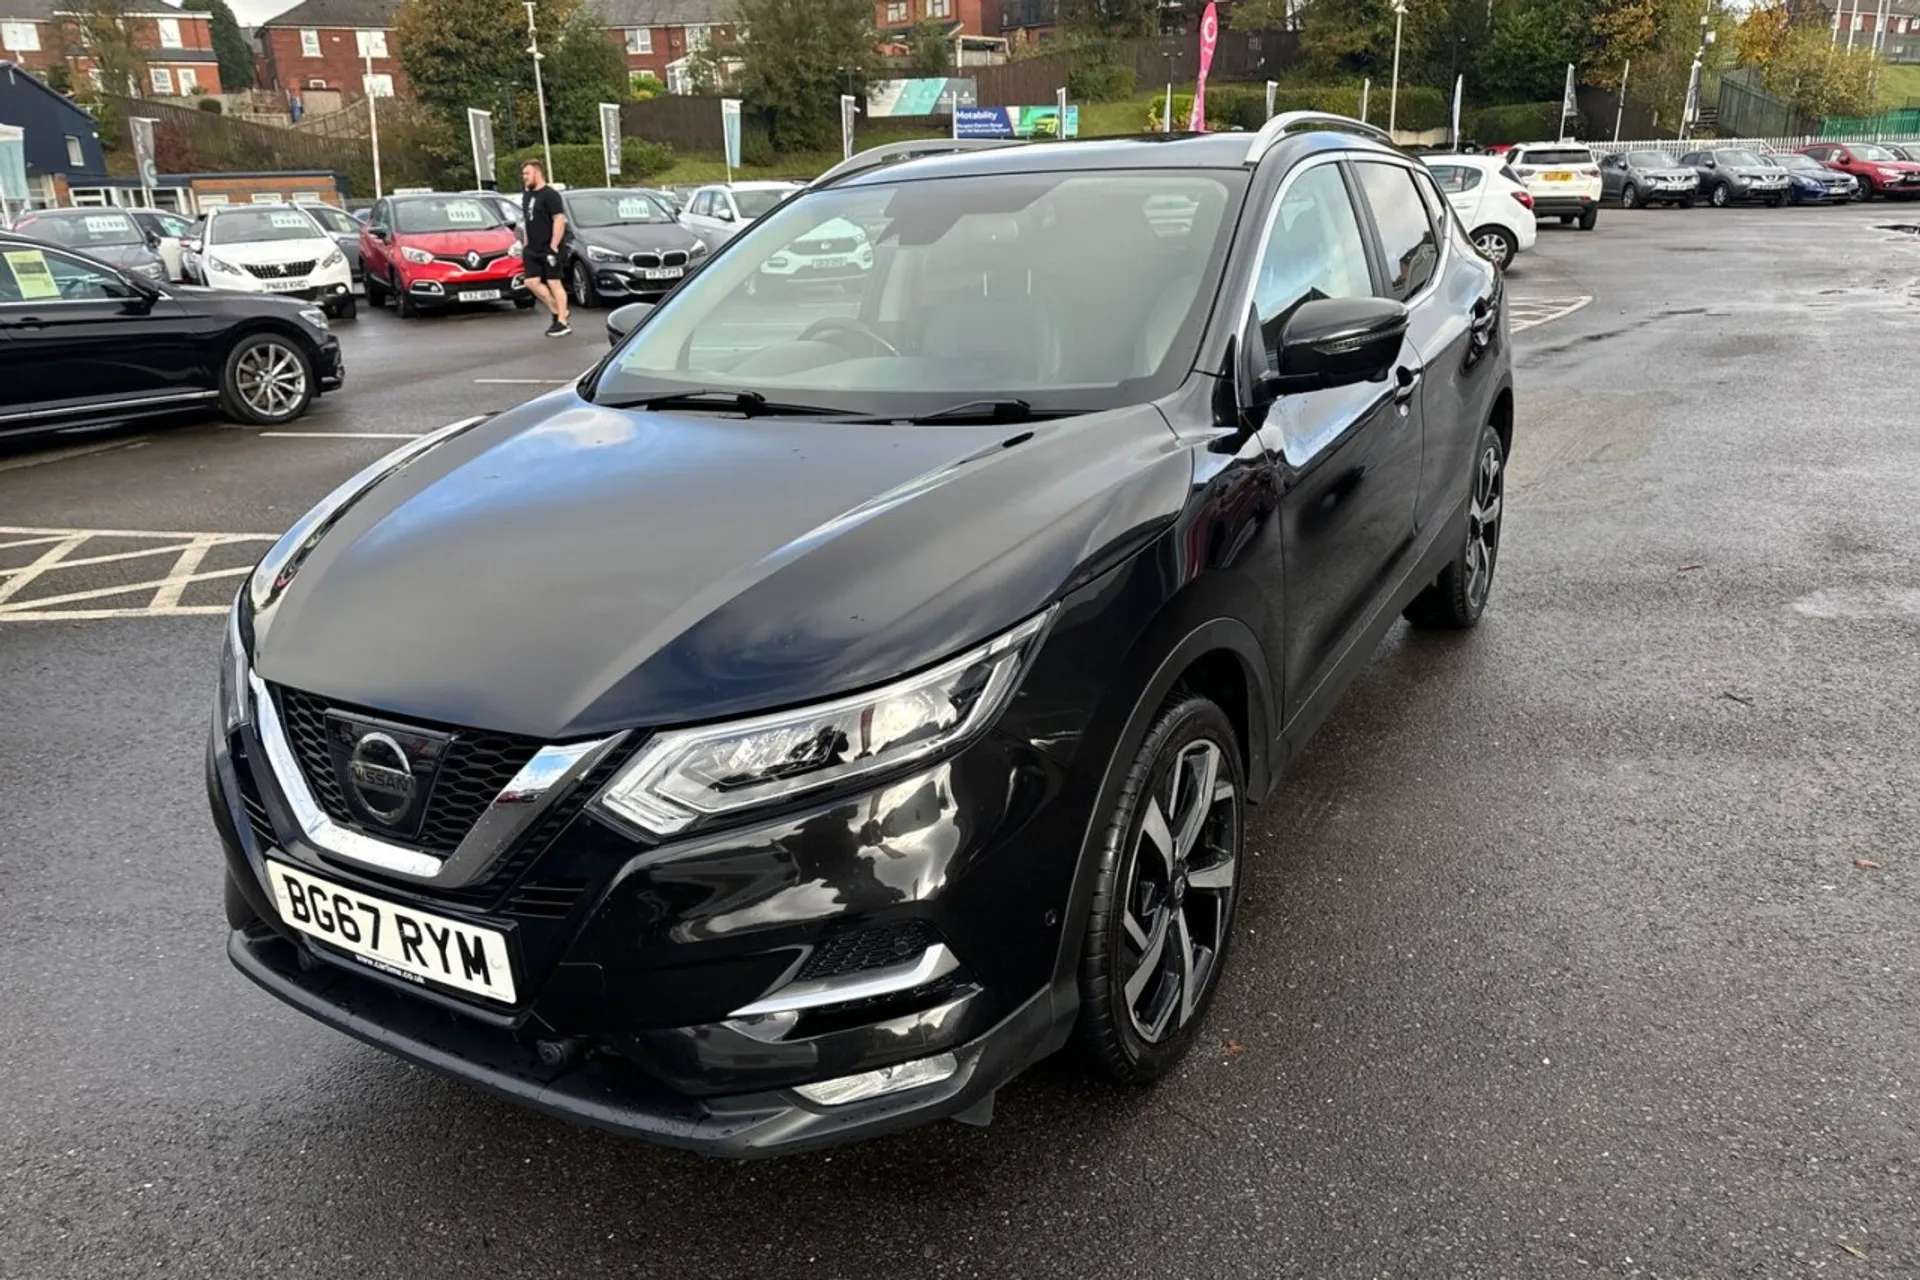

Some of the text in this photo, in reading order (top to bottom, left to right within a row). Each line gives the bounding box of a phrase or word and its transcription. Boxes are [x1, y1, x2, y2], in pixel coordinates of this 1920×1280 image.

[956, 110, 998, 121] Motability
[353, 766, 410, 792] NISSAN
[282, 873, 492, 986] BG67 RYM
